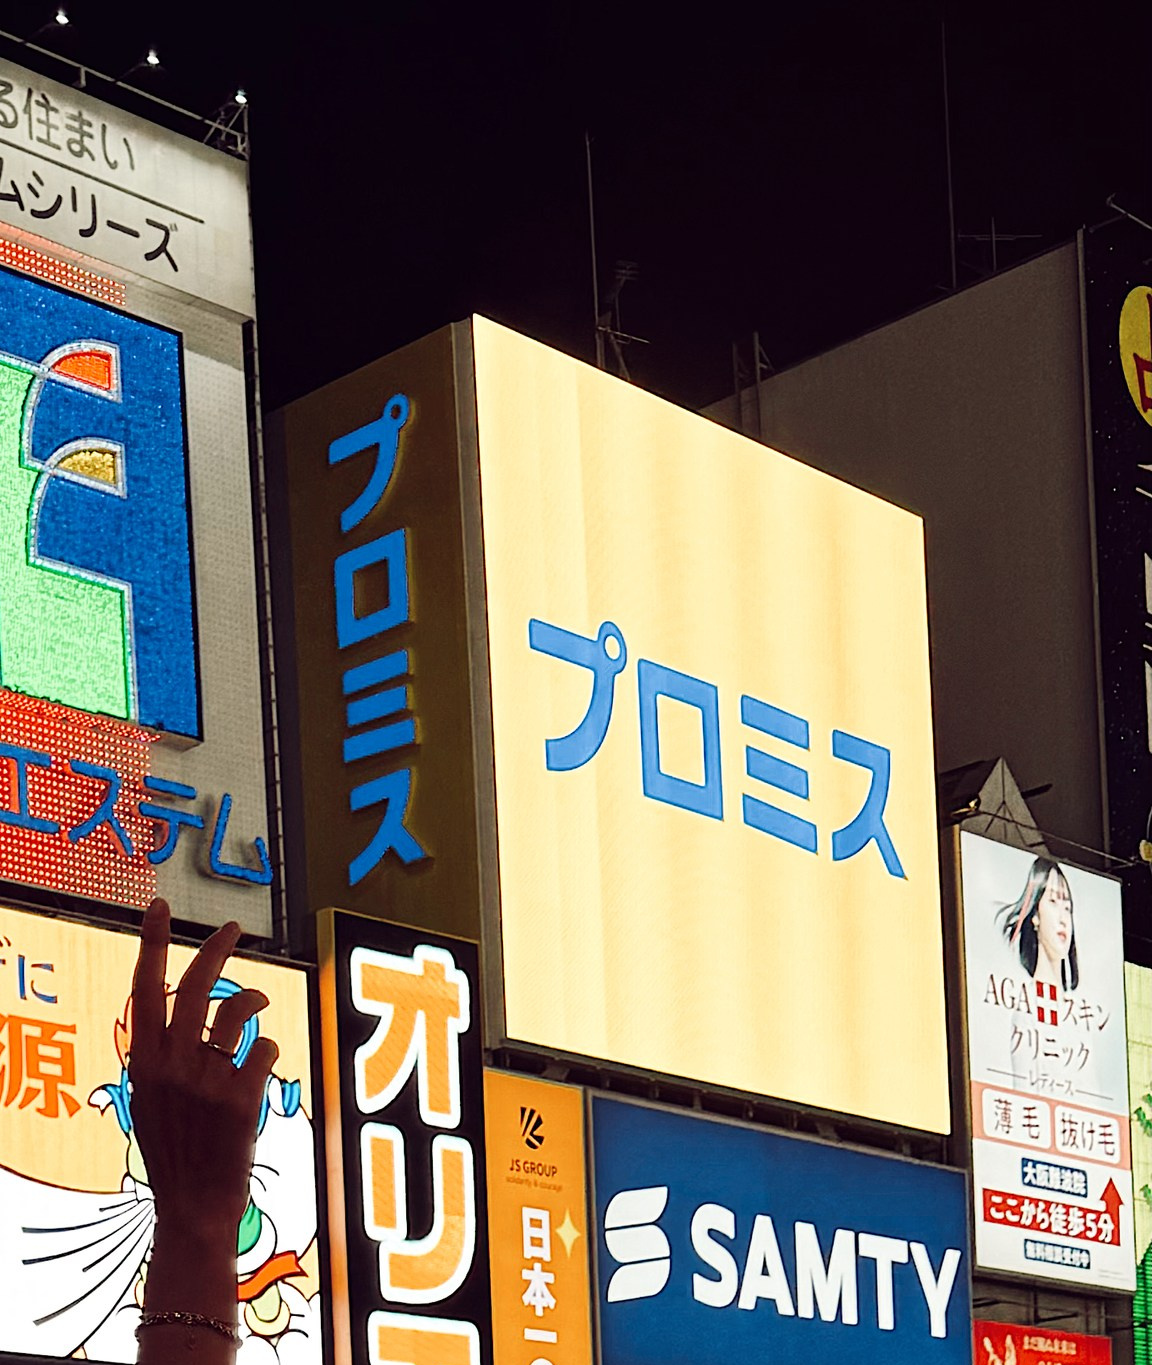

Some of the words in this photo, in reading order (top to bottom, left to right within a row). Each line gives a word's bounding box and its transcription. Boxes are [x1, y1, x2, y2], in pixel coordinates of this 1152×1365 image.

[329, 393, 433, 886] プロミス
[529, 618, 908, 881] プロミス
[984, 973, 1033, 1015] AGA
[1062, 996, 1111, 1032] スキン
[1011, 1023, 1090, 1072] クリニック
[1061, 1112, 1116, 1156] 抜け毛
[522, 1160, 558, 1178] GROUP
[989, 1194, 1115, 1244] ここから徒歩5分
[689, 1201, 961, 1340] SAMTY
